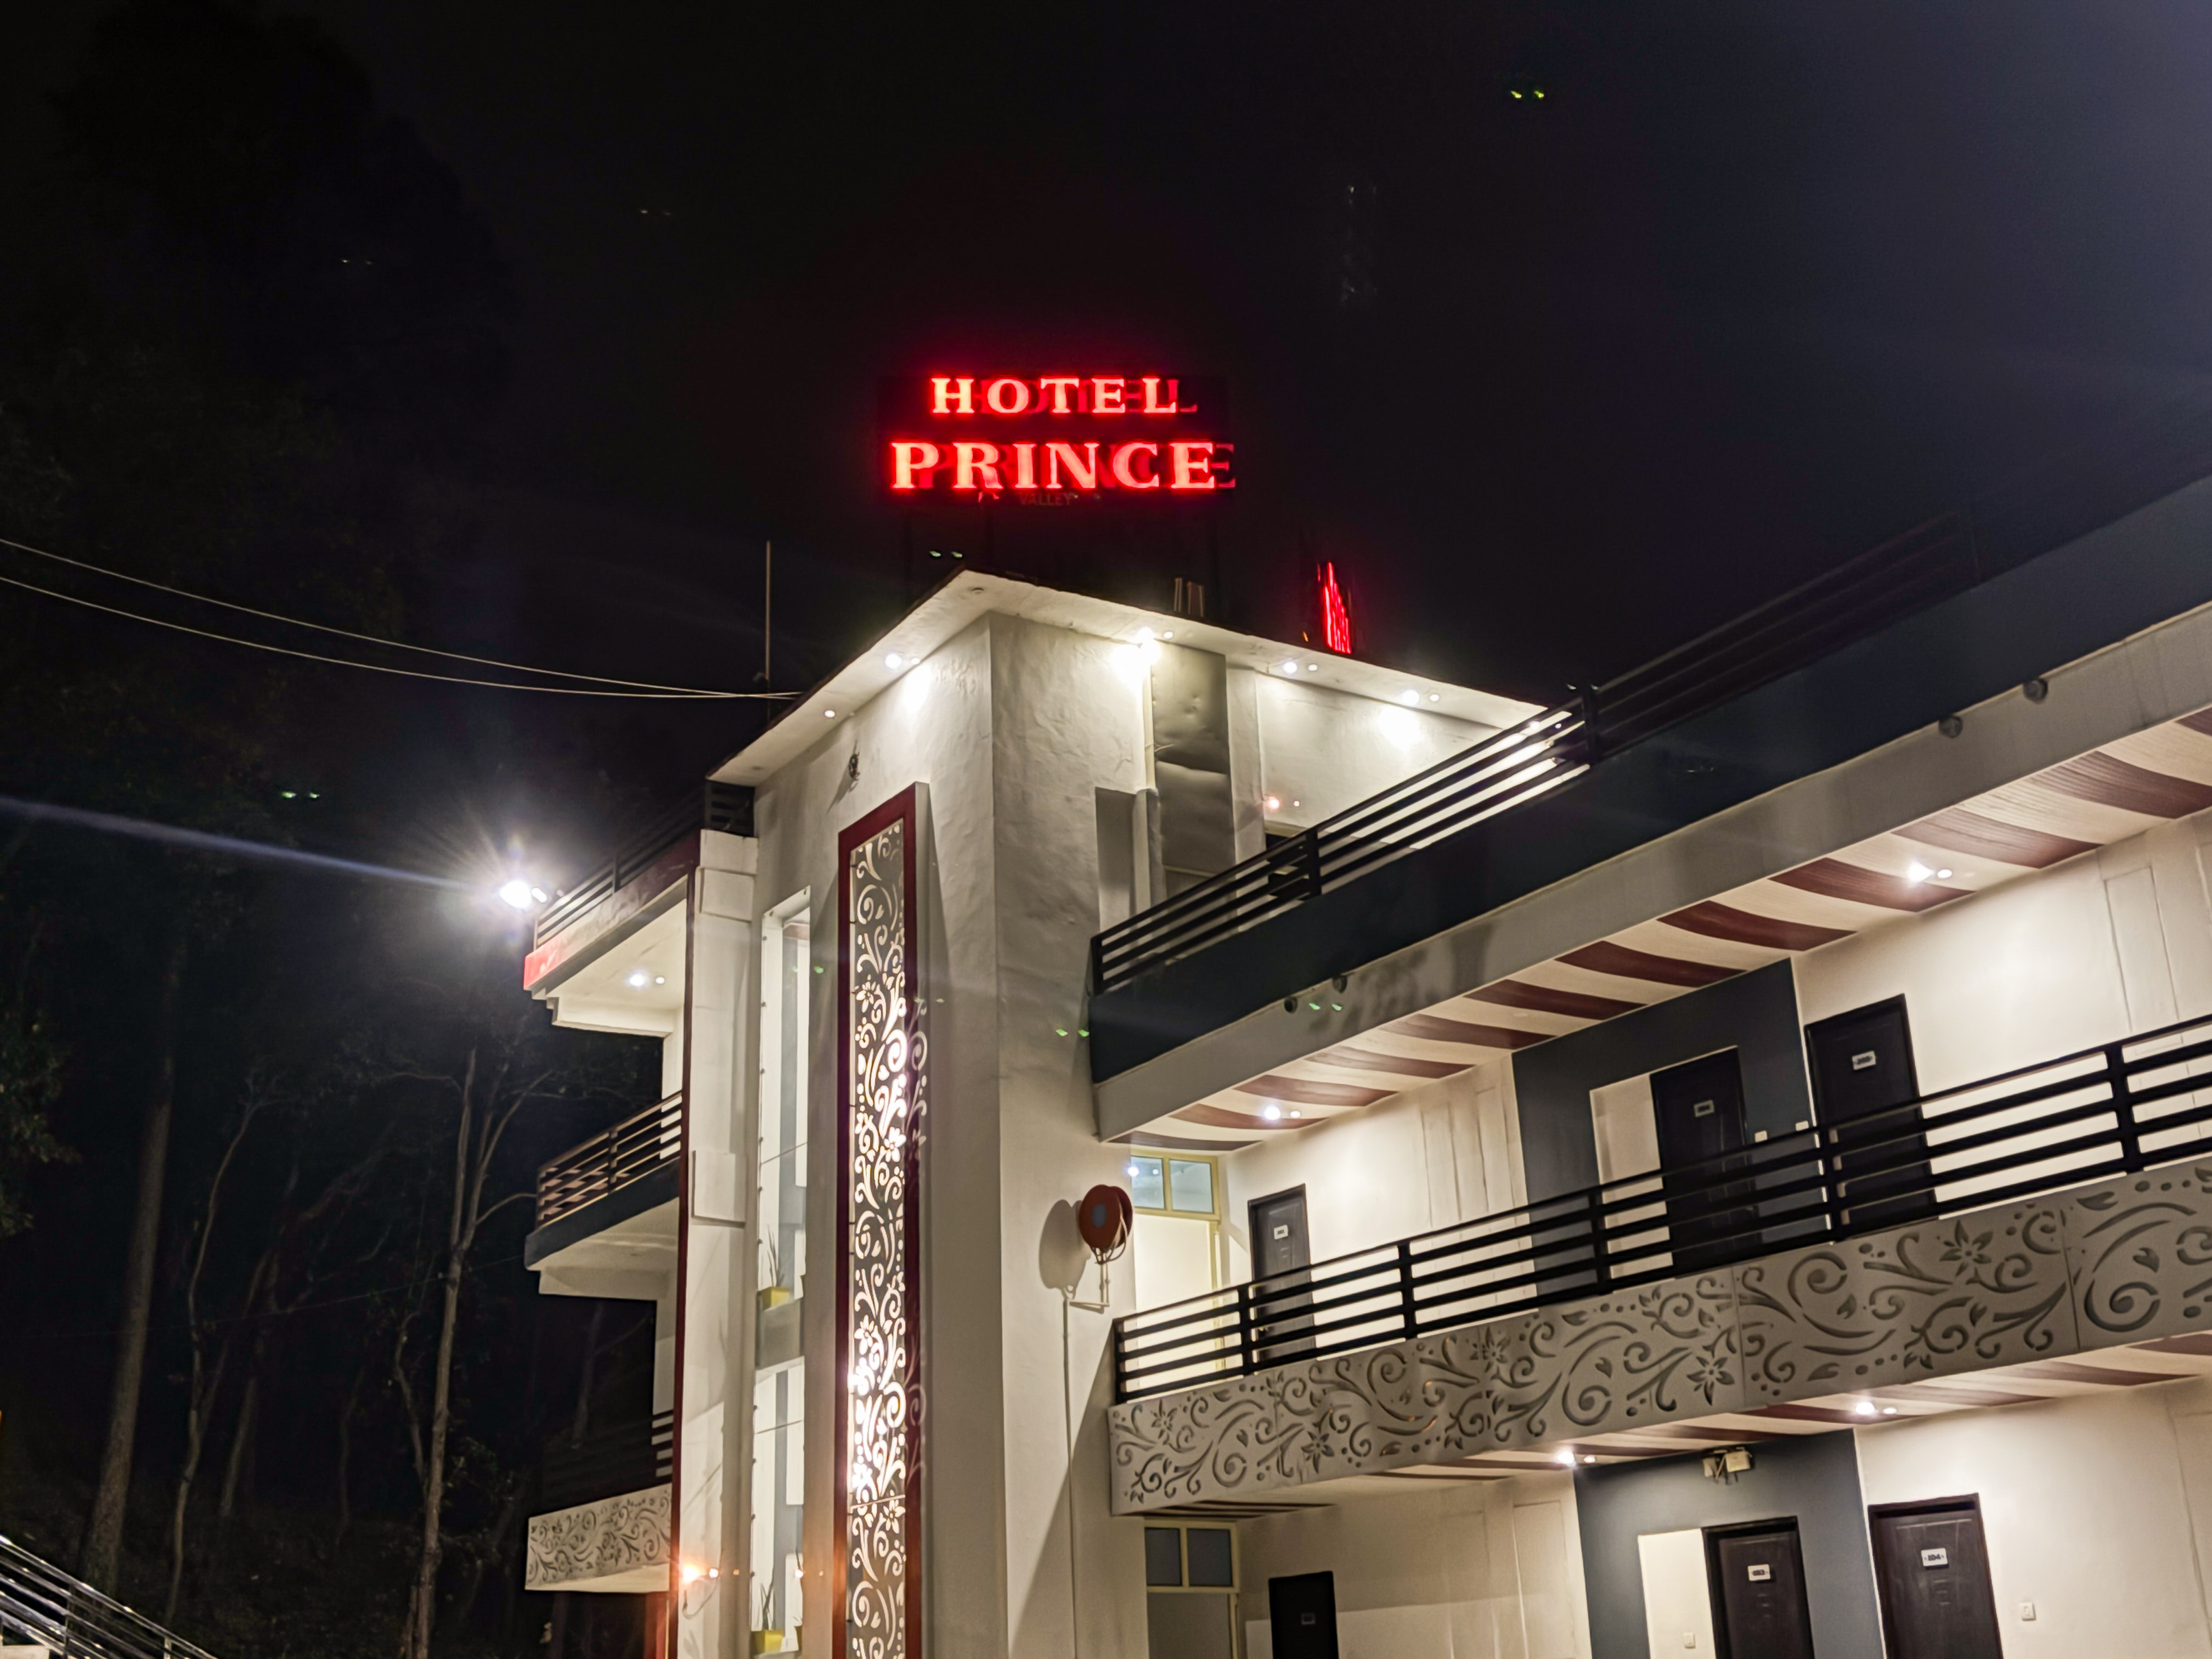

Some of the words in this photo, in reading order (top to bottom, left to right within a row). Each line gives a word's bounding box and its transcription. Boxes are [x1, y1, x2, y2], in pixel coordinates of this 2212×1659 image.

[930, 377, 1177, 414] HOTEL
[890, 442, 1216, 489] PRINCE
[1019, 492, 1072, 505] VALLEY
